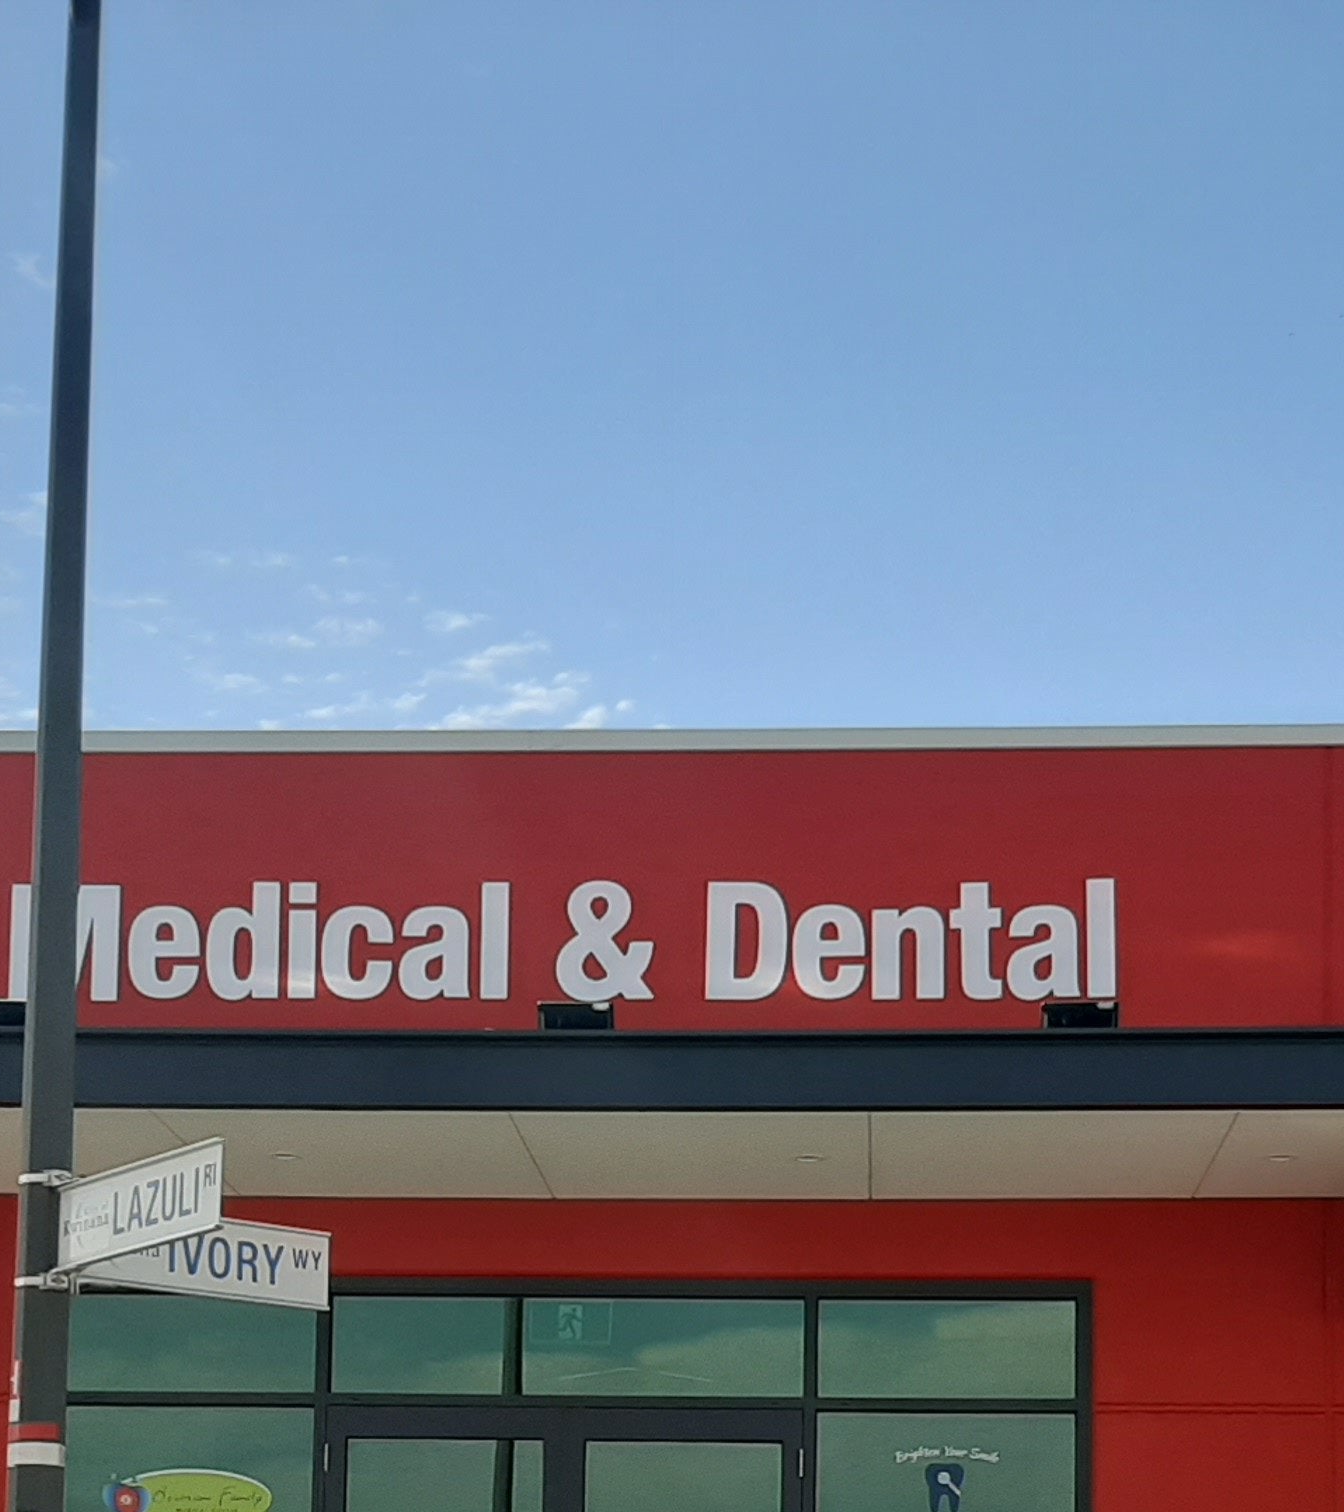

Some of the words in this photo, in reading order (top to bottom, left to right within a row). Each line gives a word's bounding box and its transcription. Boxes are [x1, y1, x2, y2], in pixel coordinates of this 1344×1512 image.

[8, 880, 510, 1002] Medical
[555, 880, 656, 1002] &
[704, 878, 1117, 1002] Dental
[112, 1166, 200, 1236] LAZULI
[168, 1234, 285, 1286] IVORY
[293, 1248, 322, 1271] WY
